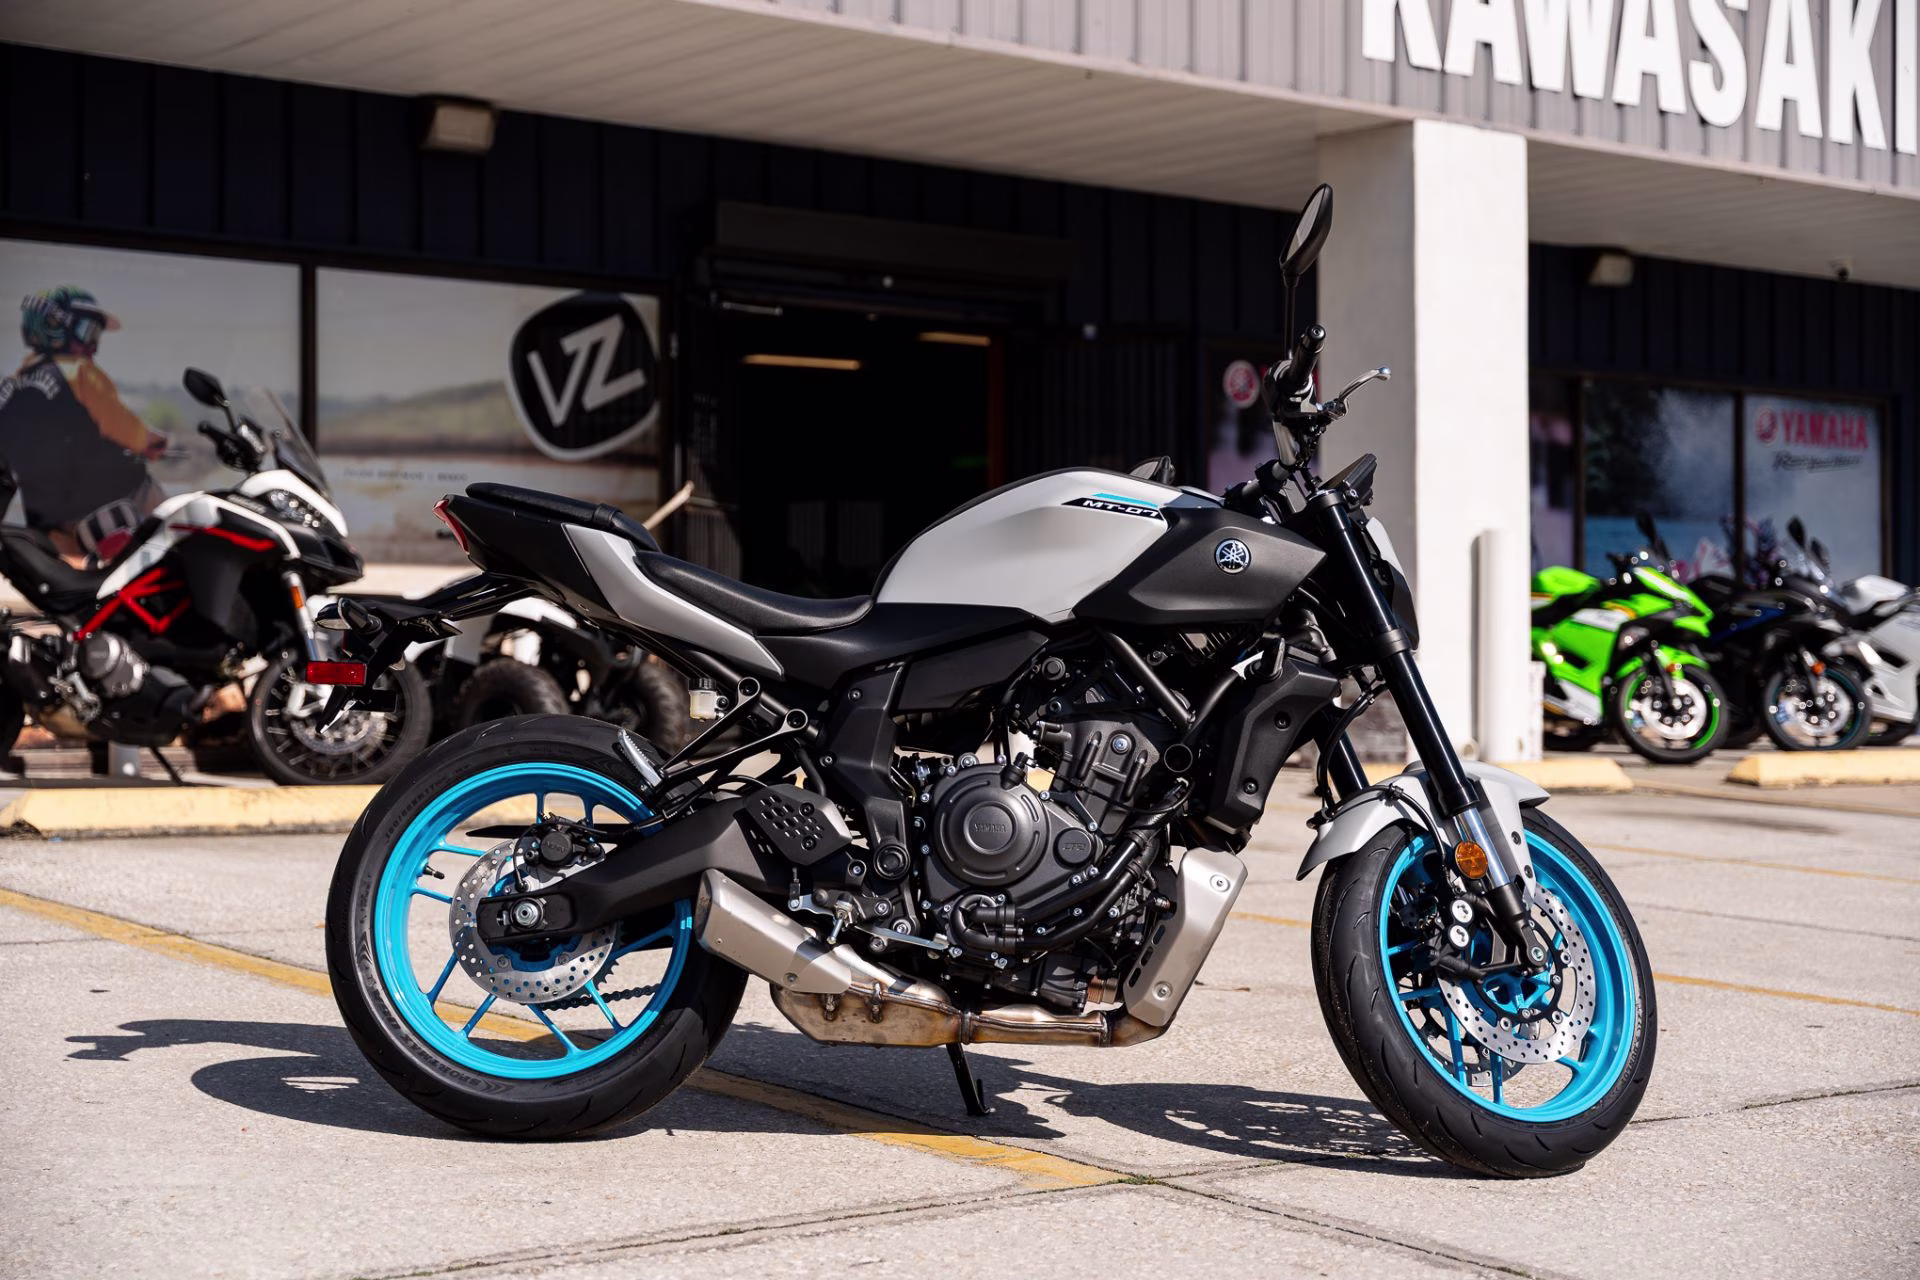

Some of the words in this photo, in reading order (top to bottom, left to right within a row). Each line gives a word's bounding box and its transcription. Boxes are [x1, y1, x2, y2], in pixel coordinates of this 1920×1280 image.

[527, 314, 648, 427] VZ
[1781, 410, 1869, 449] YAMAHA
[1083, 499, 1159, 517] MT-07
